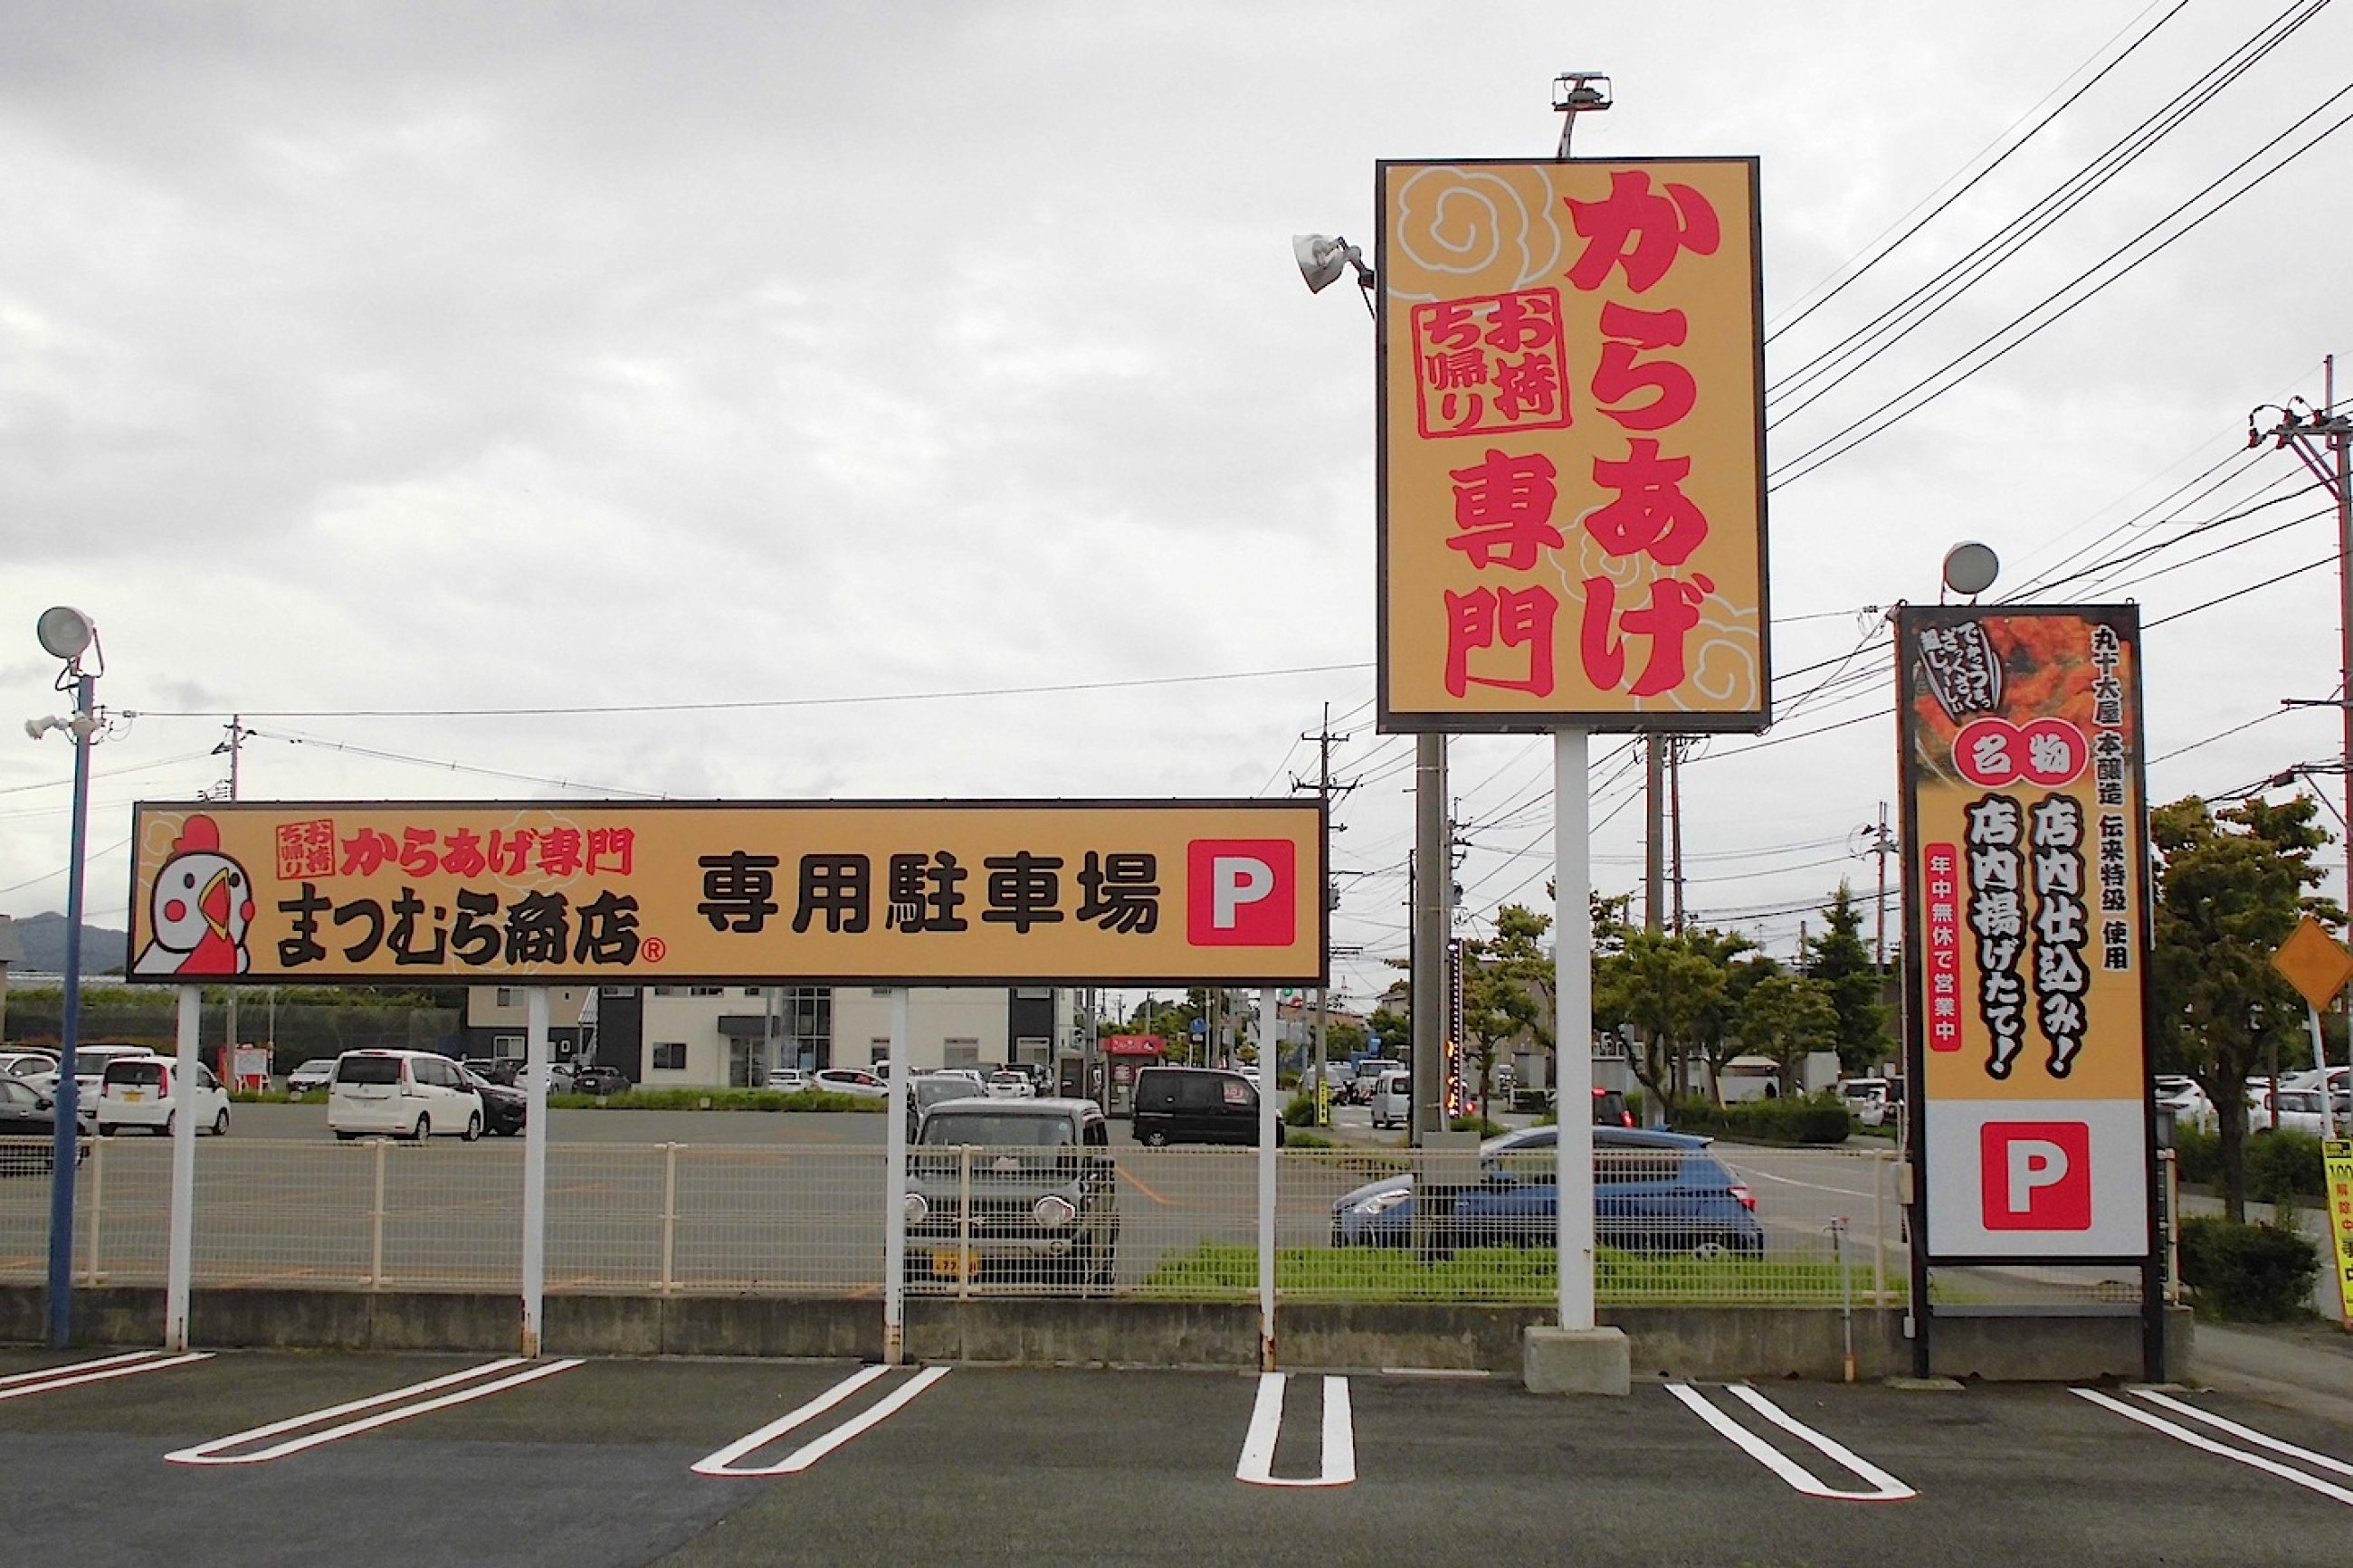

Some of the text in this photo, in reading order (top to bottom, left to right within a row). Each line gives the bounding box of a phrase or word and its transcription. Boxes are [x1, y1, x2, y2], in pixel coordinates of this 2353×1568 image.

[1424, 306, 1489, 432] ち帰り
[1486, 297, 1558, 422] お持
[1564, 170, 1720, 697] からあげ
[1444, 448, 1565, 698] 専門
[2093, 626, 2121, 725] 丸十大屋
[1972, 734, 2072, 774] 名物
[2096, 732, 2123, 805] 本醸造
[339, 826, 634, 879] からあげ専門
[698, 851, 1161, 935] 専用駐車場
[1213, 856, 1275, 929] P
[277, 882, 640, 967] まつむら商店
[1929, 855, 1956, 1041] 年中無休で営業中
[2102, 919, 2128, 971] 使用
[2006, 1139, 2070, 1213] P
